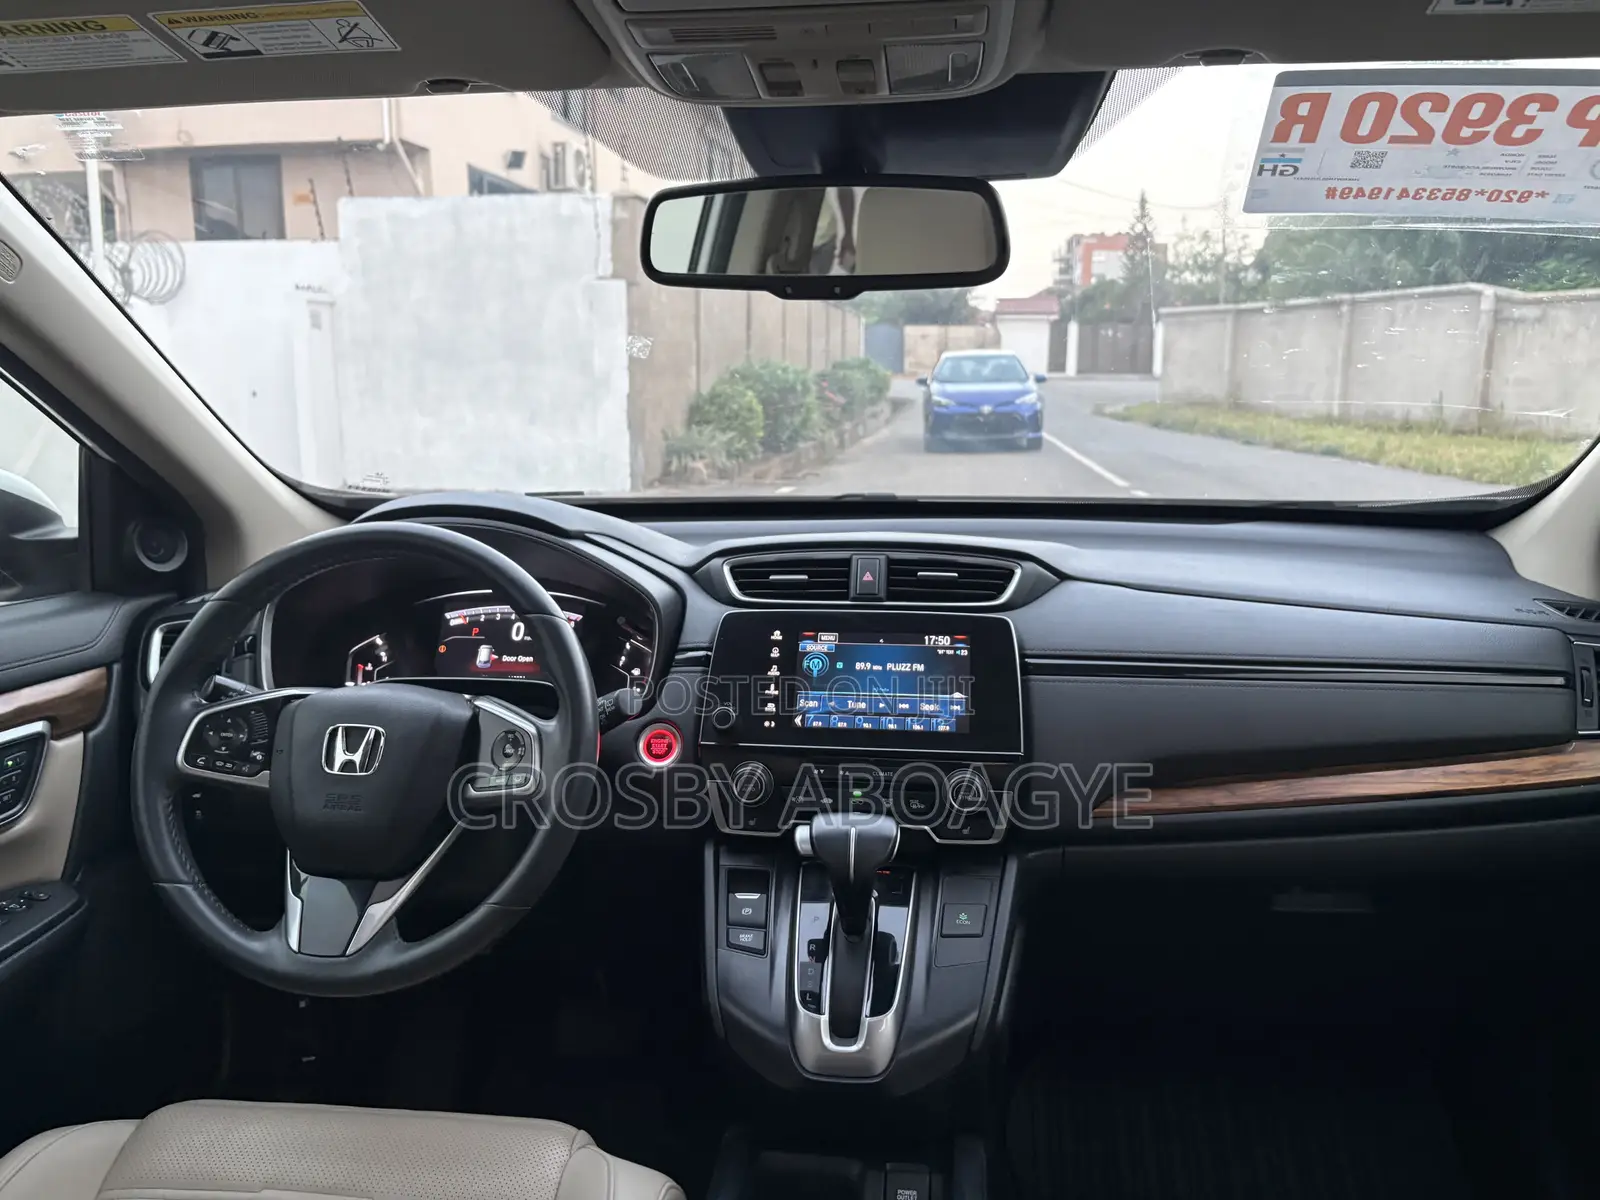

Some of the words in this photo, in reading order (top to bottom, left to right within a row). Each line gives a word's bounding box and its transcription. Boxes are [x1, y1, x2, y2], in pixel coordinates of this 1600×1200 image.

[0, 20, 107, 37] ARNING
[472, 627, 479, 636] P
[511, 621, 525, 641] 0
[924, 635, 951, 645] 17:50
[502, 654, 517, 662] Door
[517, 655, 534, 663] Open
[855, 662, 871, 671] 89.9
[886, 663, 911, 672] PLUZZ
[912, 663, 925, 672] FM
[799, 699, 819, 707] Scan
[847, 700, 867, 709] Tune
[920, 702, 939, 711] Seek
[809, 943, 816, 951] R
